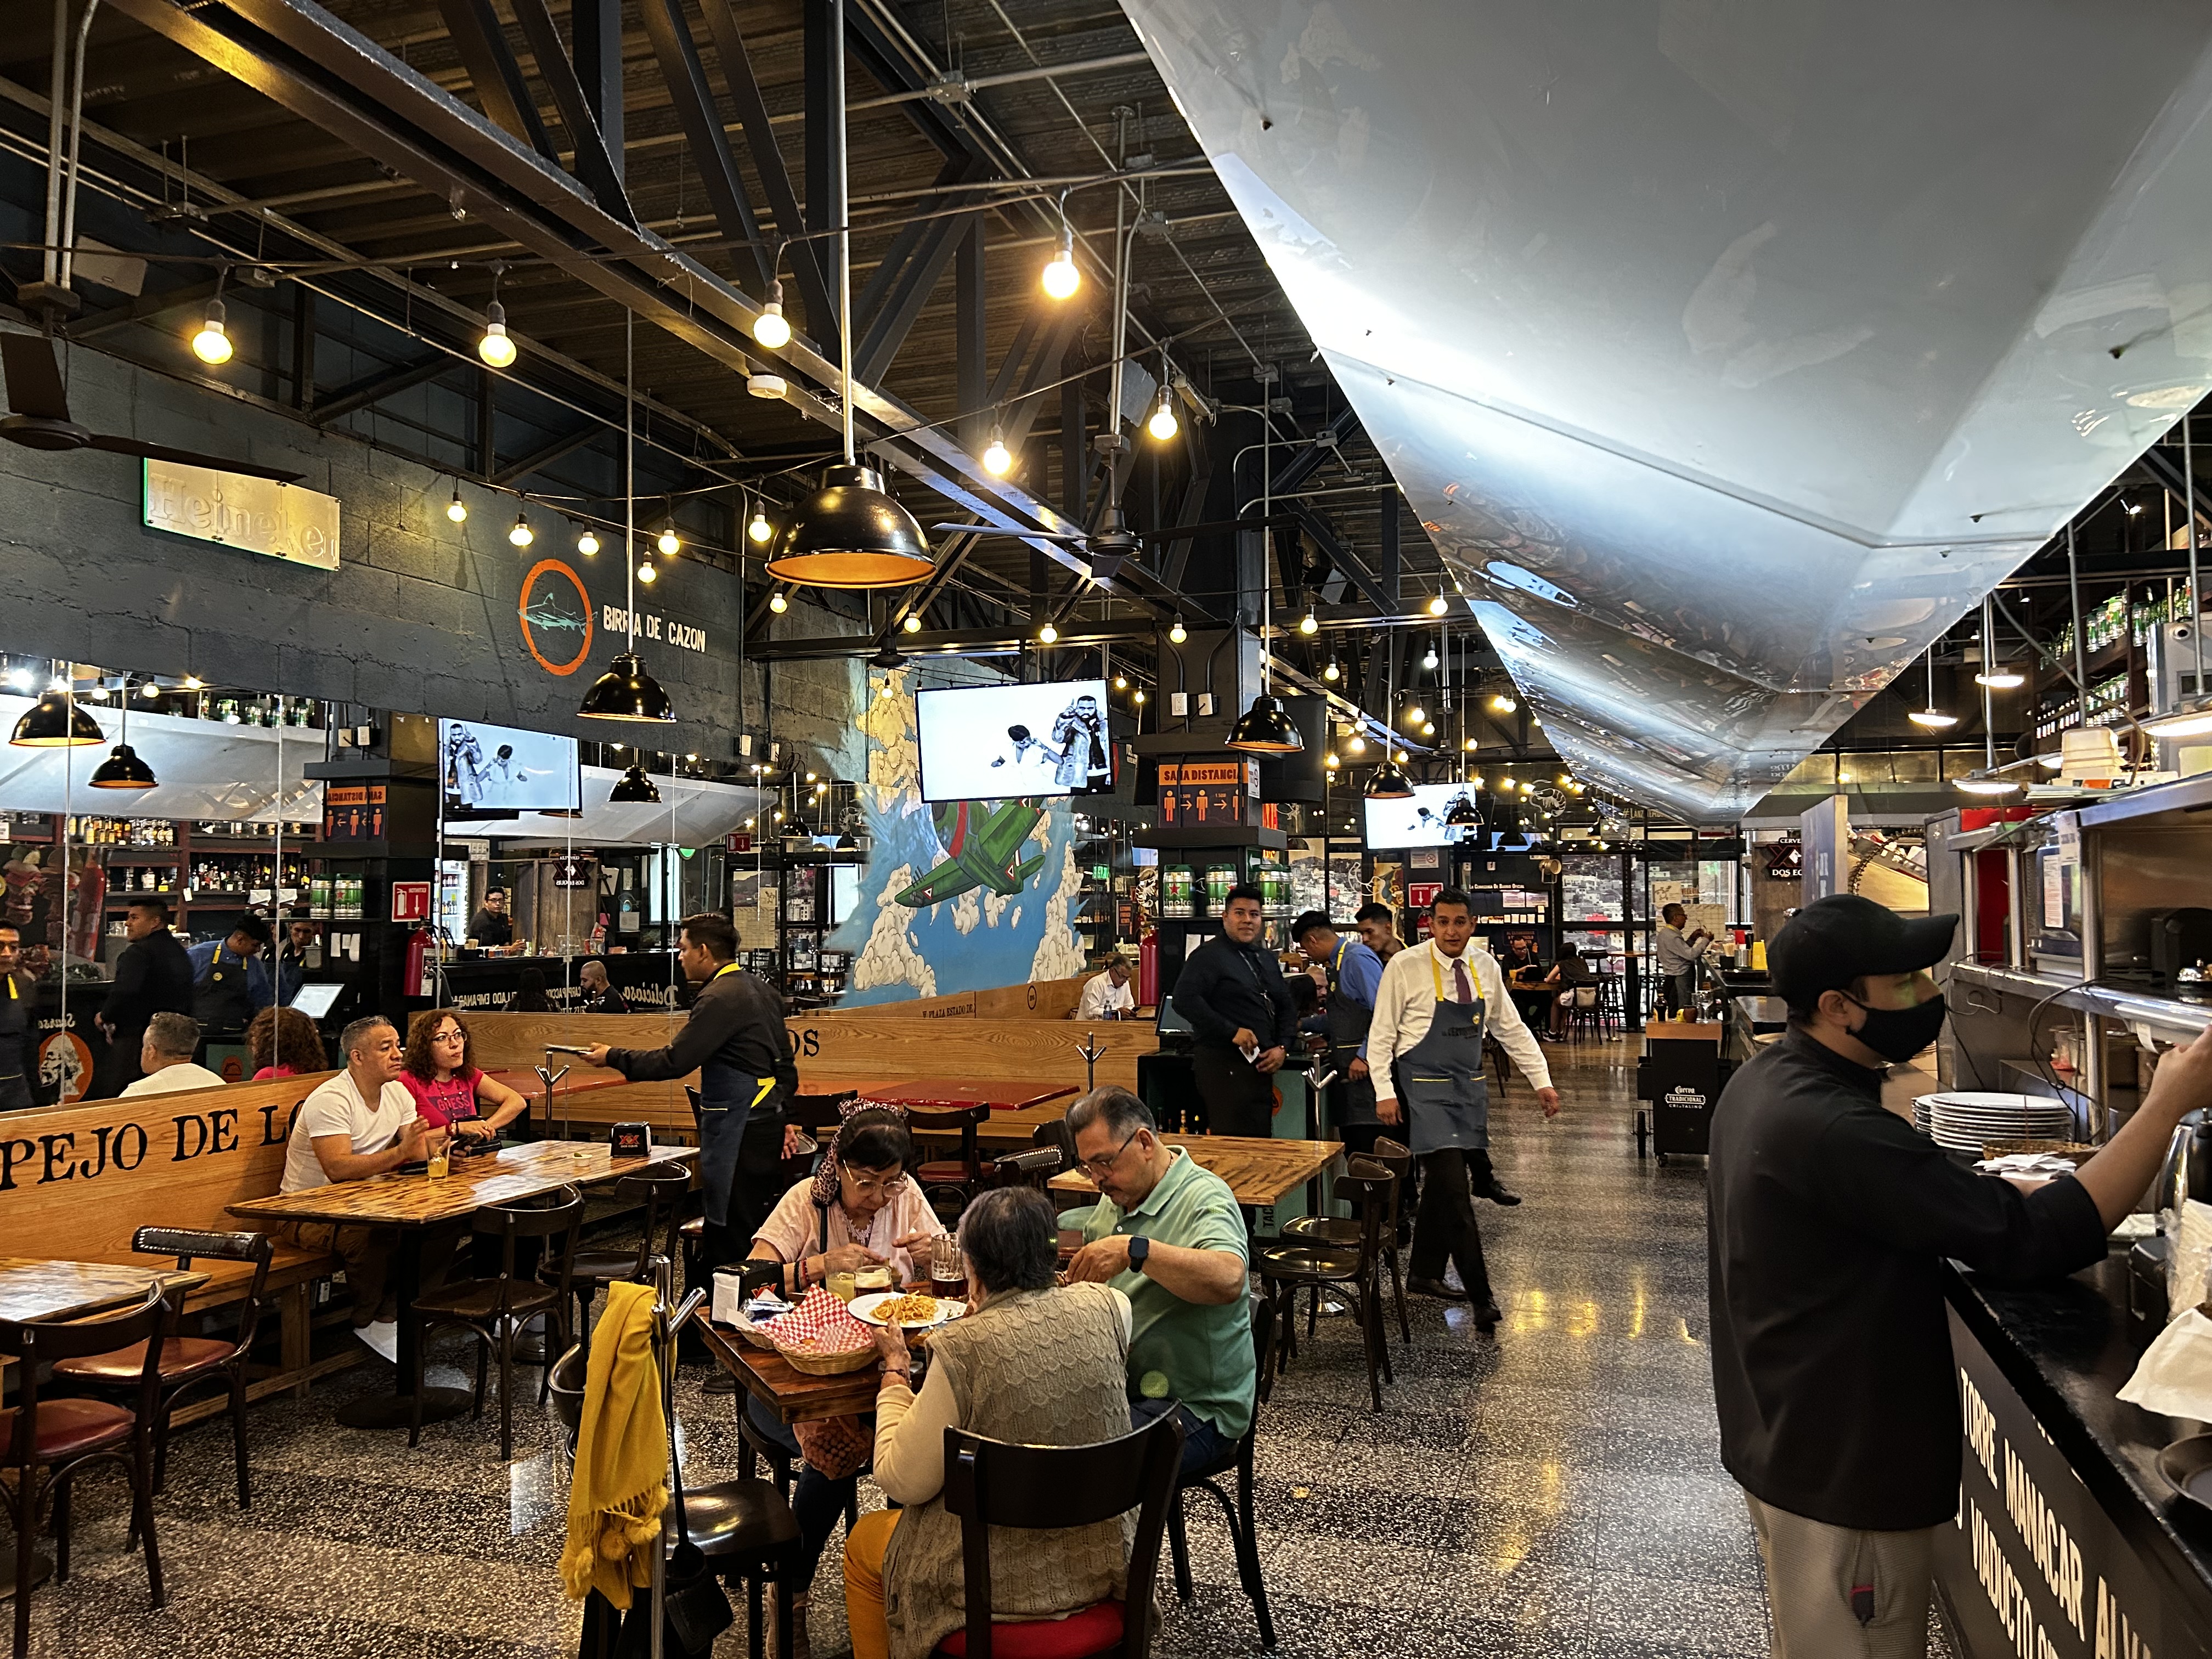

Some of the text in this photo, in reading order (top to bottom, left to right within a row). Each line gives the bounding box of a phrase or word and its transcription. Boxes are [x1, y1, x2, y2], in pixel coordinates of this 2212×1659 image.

[150, 472, 338, 562] Heineken
[603, 605, 706, 653] BIRRA DE CAZON
[929, 1009, 946, 1019] PLAZA
[946, 1005, 966, 1017] ESTADO
[171, 1108, 239, 1162] DE
[1961, 1366, 1997, 1489] TORRE
[2004, 1437, 2085, 1642] MANACAR
